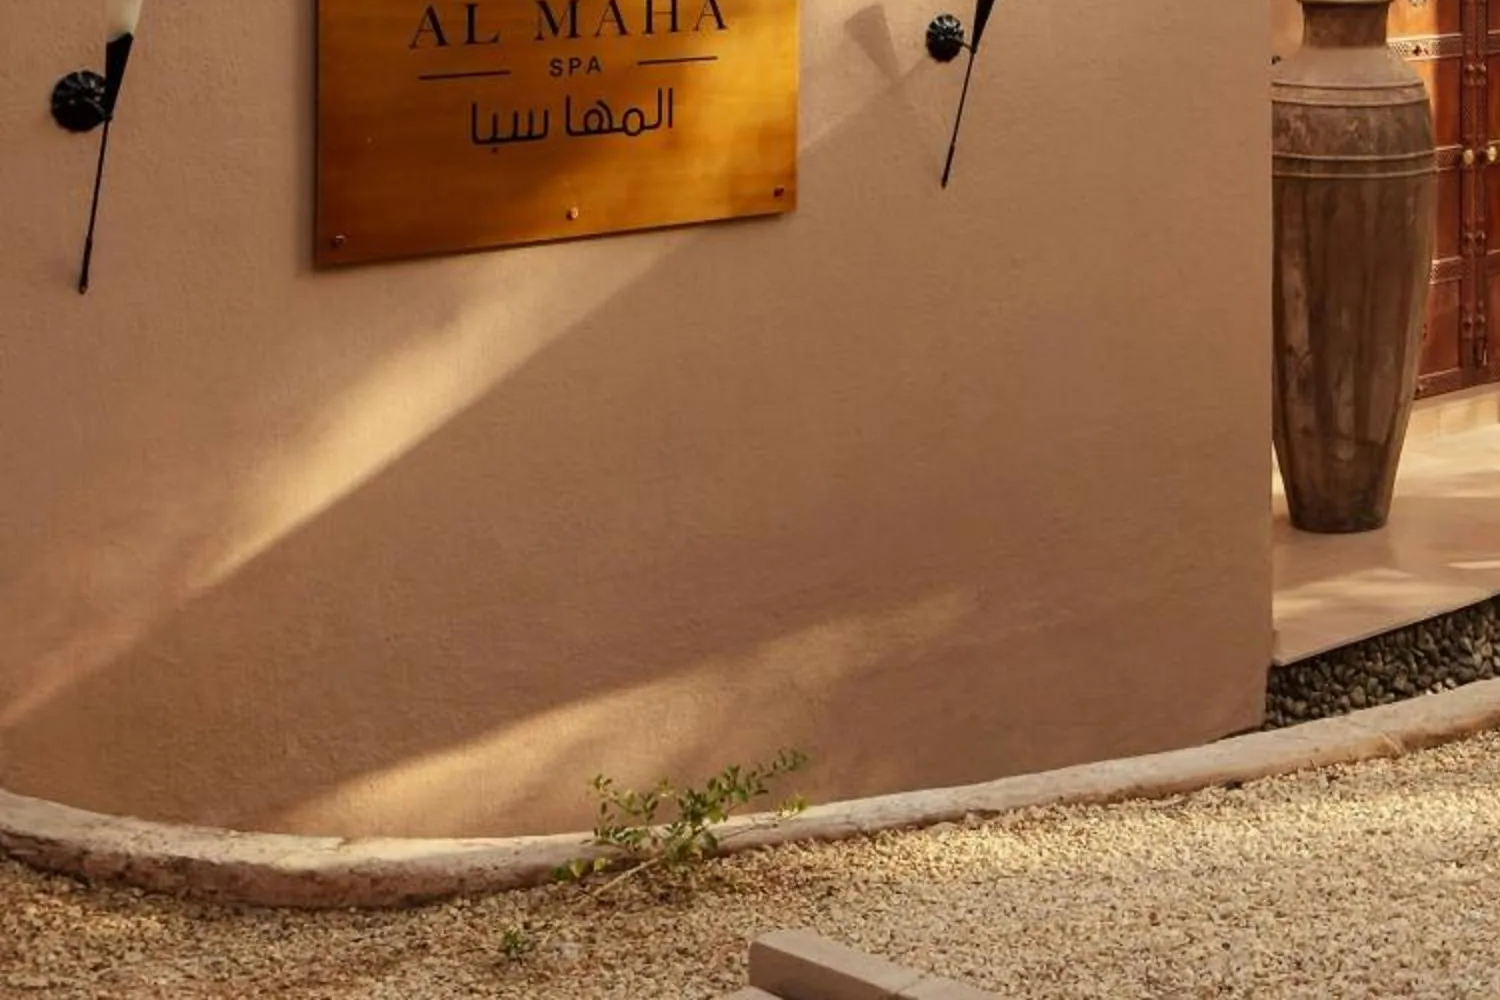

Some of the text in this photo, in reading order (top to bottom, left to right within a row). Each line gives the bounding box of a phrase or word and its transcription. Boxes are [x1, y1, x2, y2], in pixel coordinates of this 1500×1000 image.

[408, 3, 500, 49] AL
[549, 56, 602, 77] SPA
[471, 87, 673, 153] المها سبا
